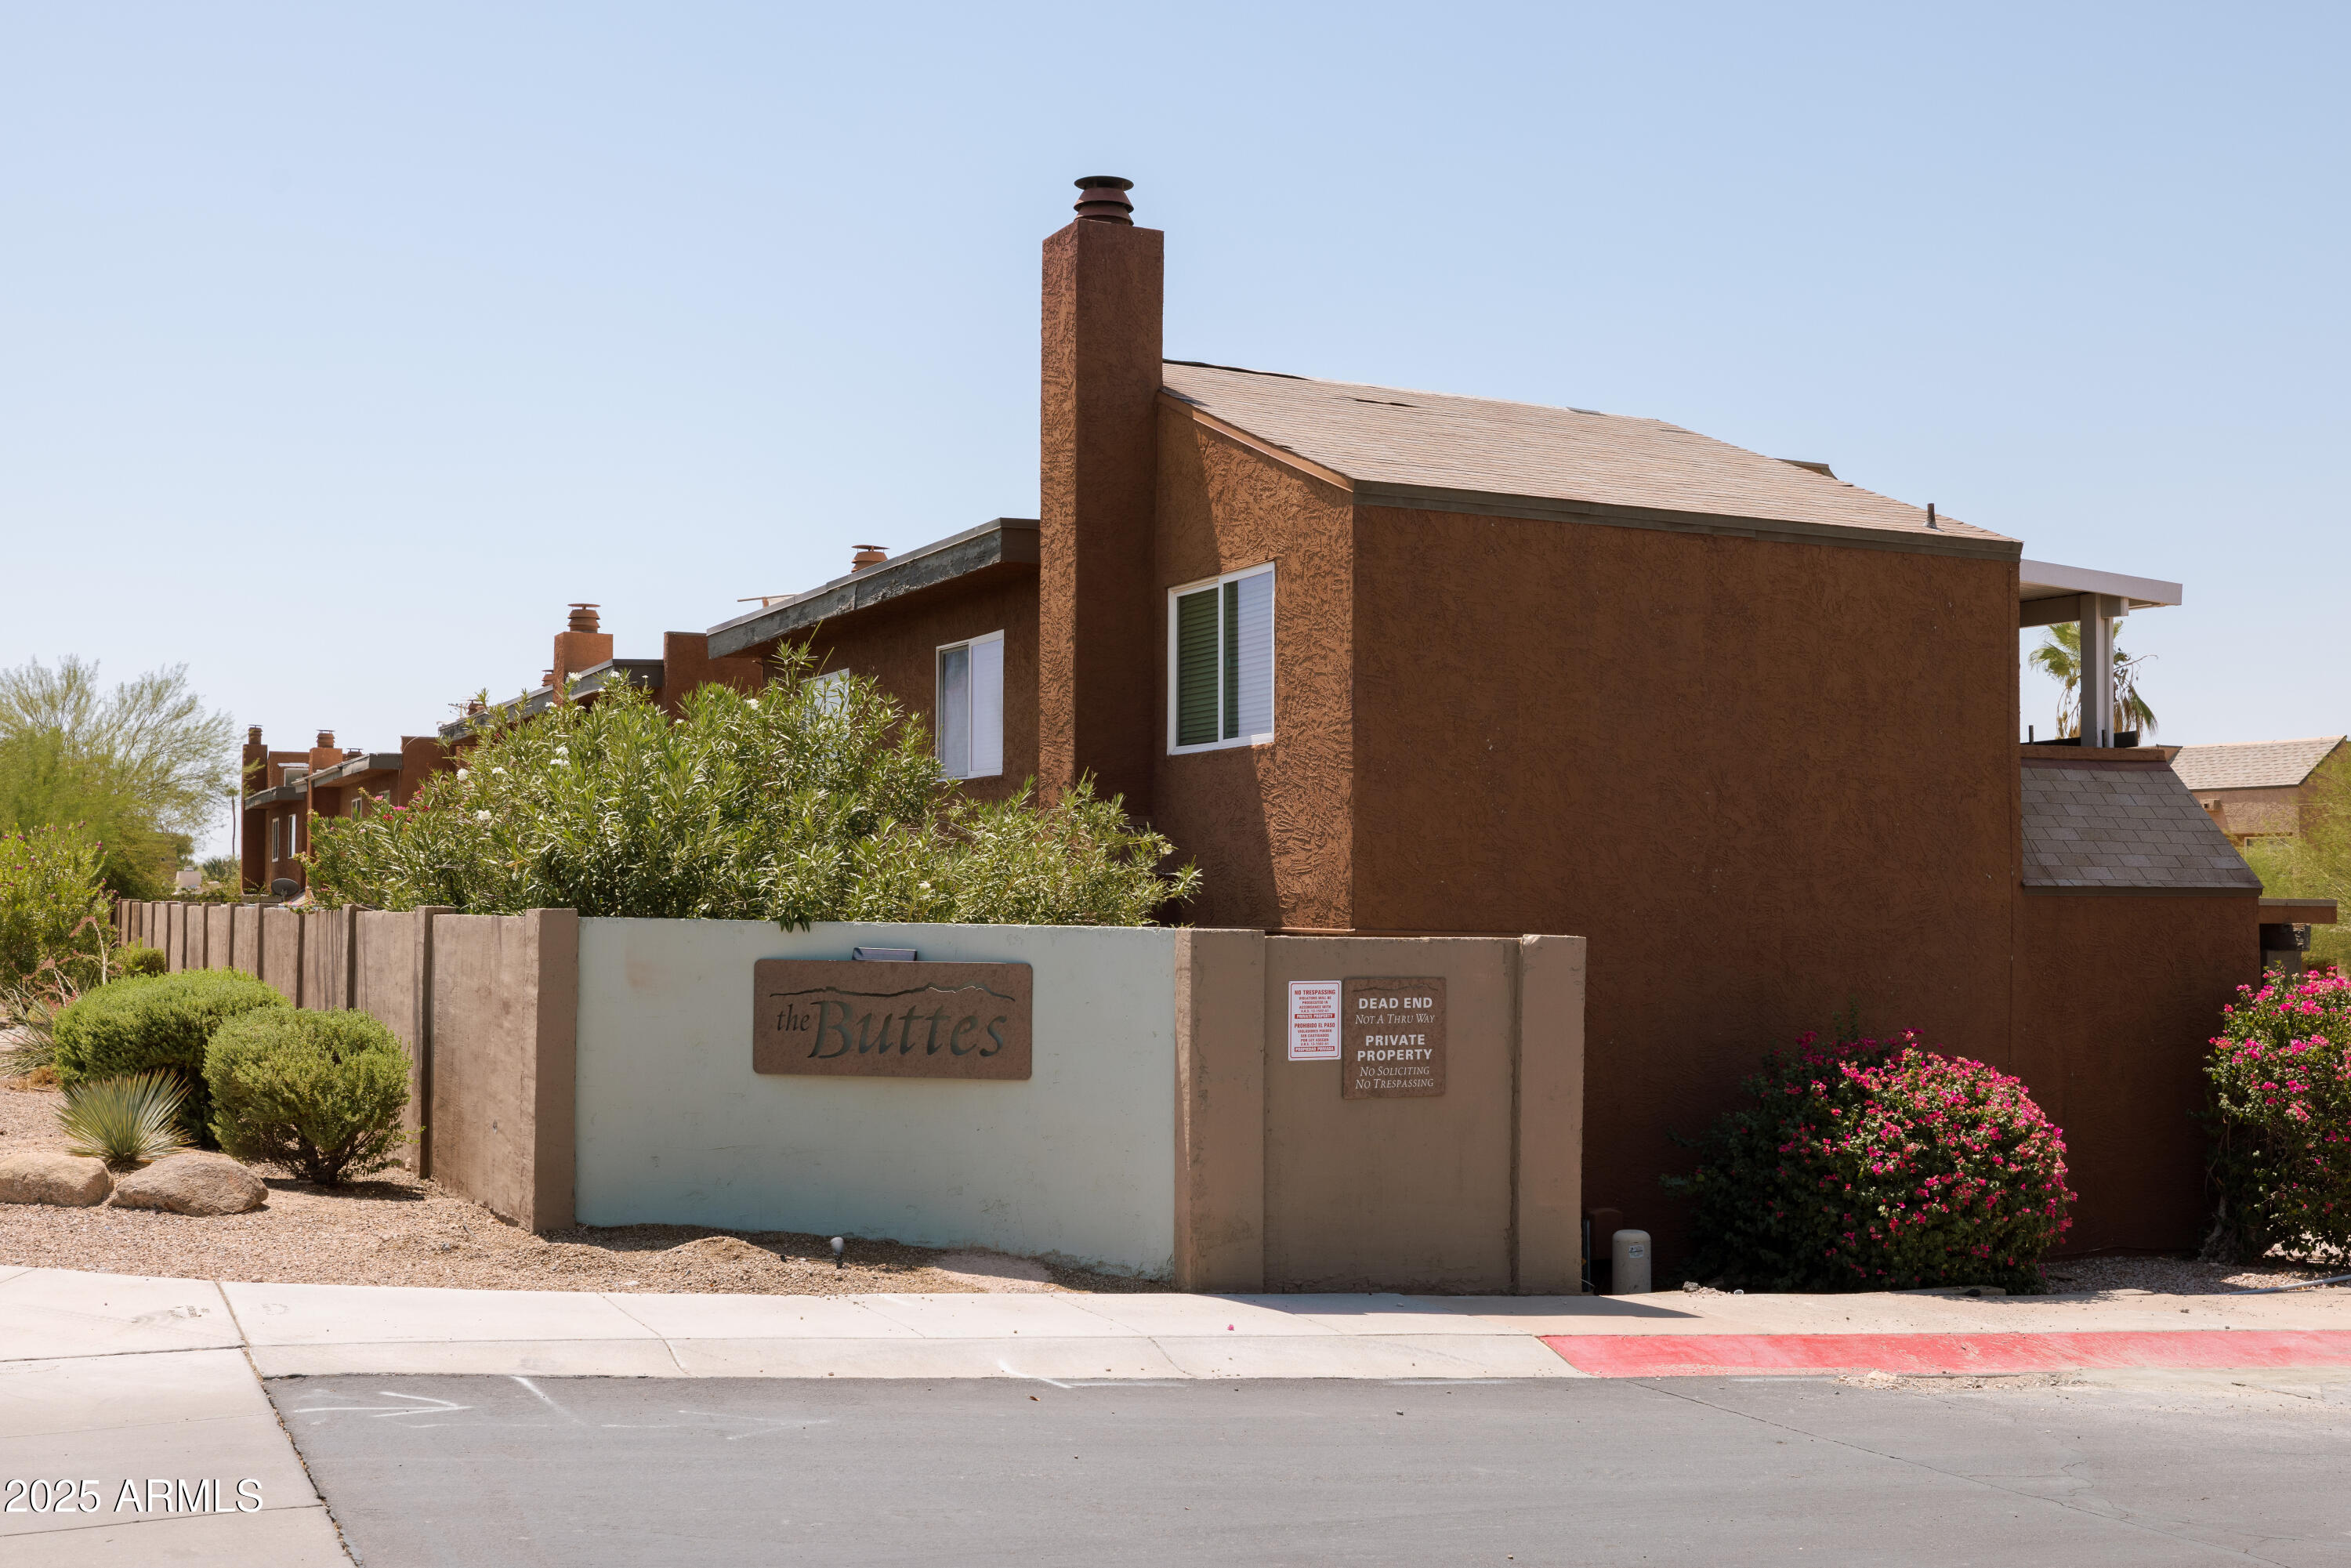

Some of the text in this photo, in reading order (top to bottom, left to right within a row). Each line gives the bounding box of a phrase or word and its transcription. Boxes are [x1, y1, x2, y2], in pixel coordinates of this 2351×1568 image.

[1358, 997, 1433, 1009] DEAD END
[1377, 1014, 1384, 1024] A
[777, 1000, 1007, 1059] the Buttes
[1366, 1034, 1425, 1046] PRIVATE
[1357, 1049, 1433, 1061] PROPERTY
